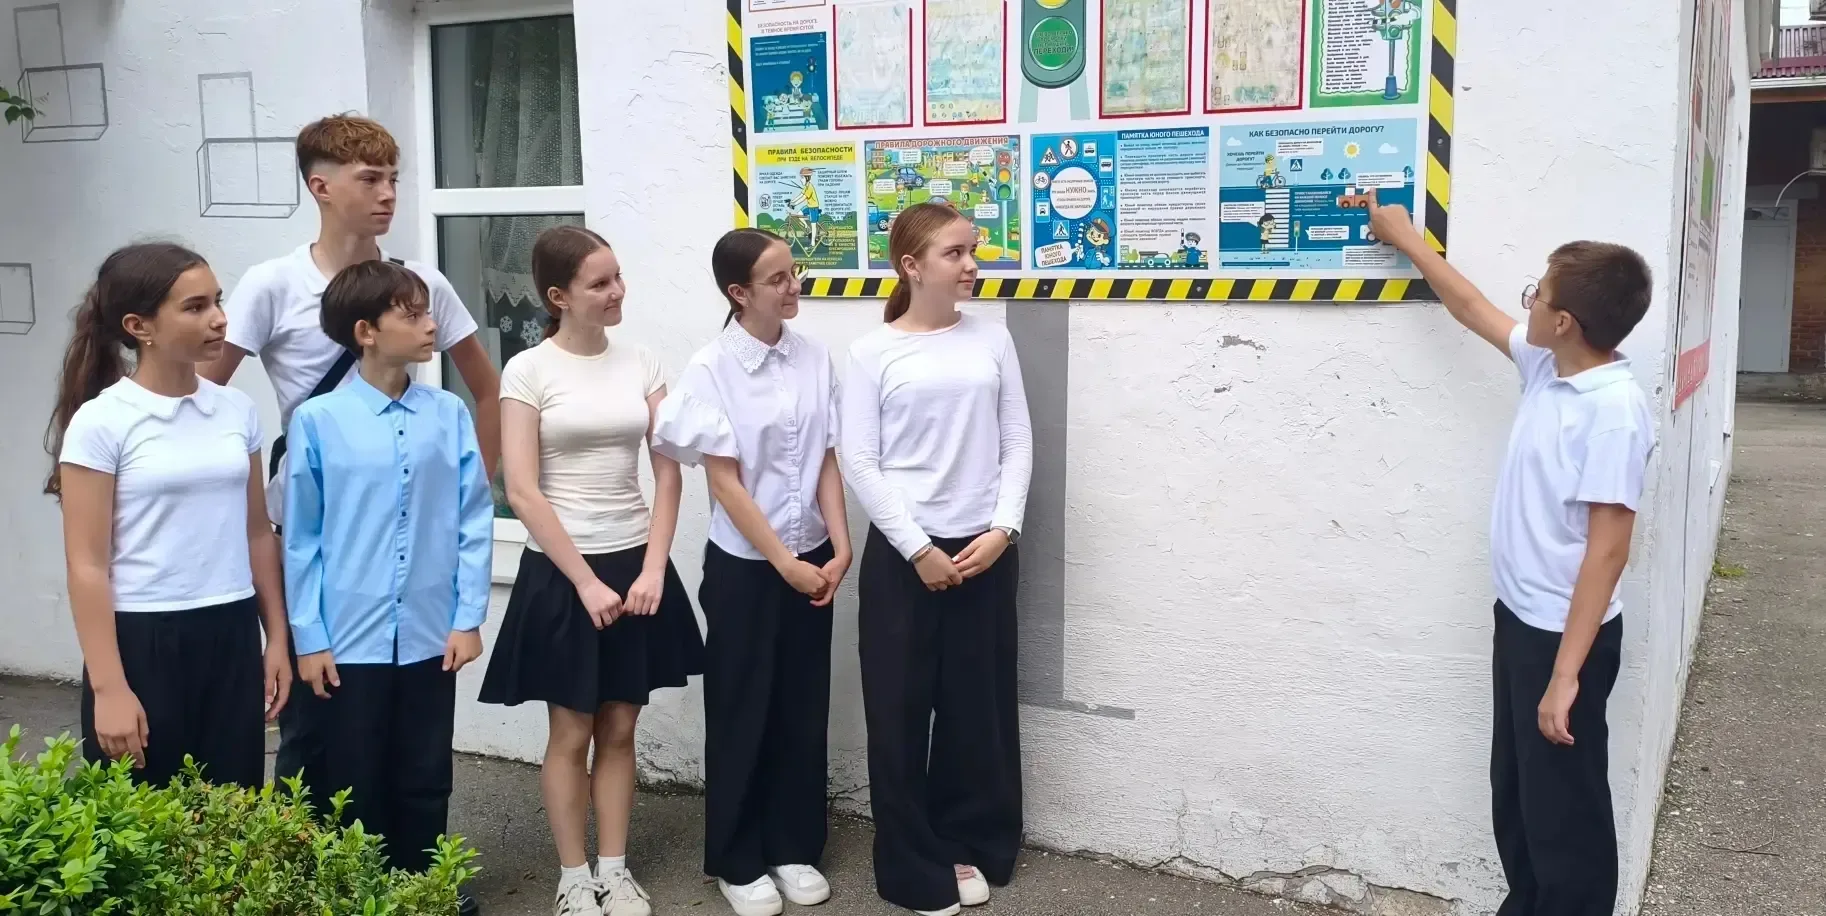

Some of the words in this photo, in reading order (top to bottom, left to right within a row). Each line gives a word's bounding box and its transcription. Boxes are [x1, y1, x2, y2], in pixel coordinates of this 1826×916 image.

[1121, 131, 1149, 140] ПАМЯТКА
[1171, 129, 1205, 137] ПЕШЕХОДА
[1265, 129, 1310, 137] БЕЗОПАСНО
[1311, 126, 1347, 135] ПЕРЕЙТИ
[1348, 125, 1385, 135] ДОРОГУ?
[875, 140, 911, 149] ПРАВИЛА
[911, 139, 962, 148] ДОРОЖНОГО
[963, 136, 1009, 146] ДВИЖЕНИЯ
[800, 146, 853, 154] БЕЗОПАСНОСТИ
[1065, 186, 1087, 194] НУЖНО
[1040, 244, 1063, 253] ПАМЯТКА
[1041, 256, 1067, 266] ПЕШЕХОДА
